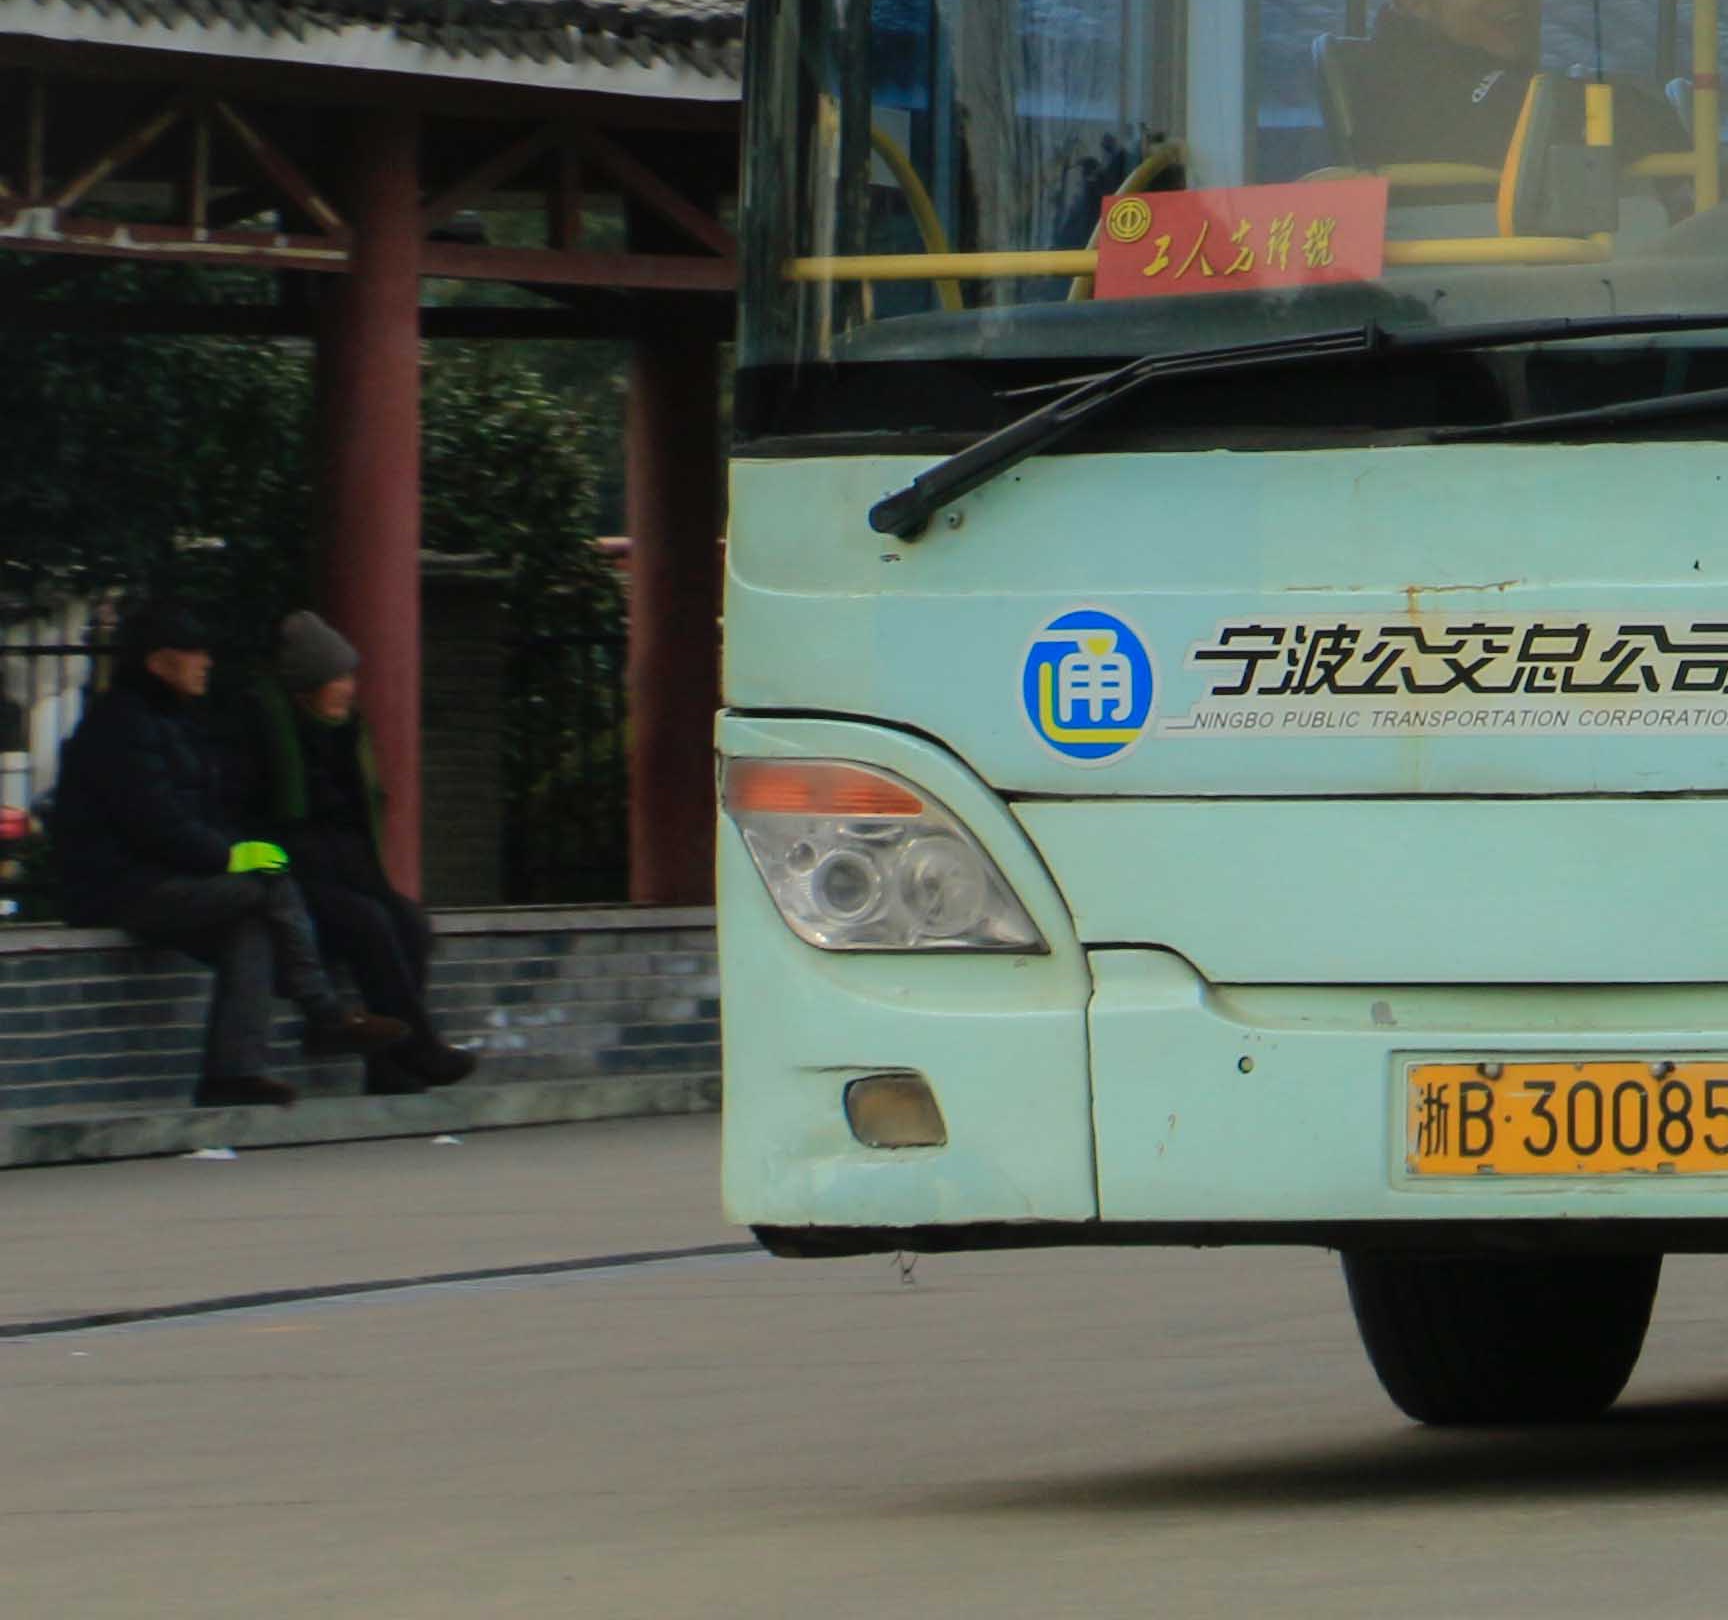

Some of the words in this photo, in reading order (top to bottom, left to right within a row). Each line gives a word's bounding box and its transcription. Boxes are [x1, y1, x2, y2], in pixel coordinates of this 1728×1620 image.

[1195, 707, 1274, 730] NINGBO
[1281, 707, 1362, 730] PUBLIC
[1369, 707, 1570, 730] TRANSPORTATION
